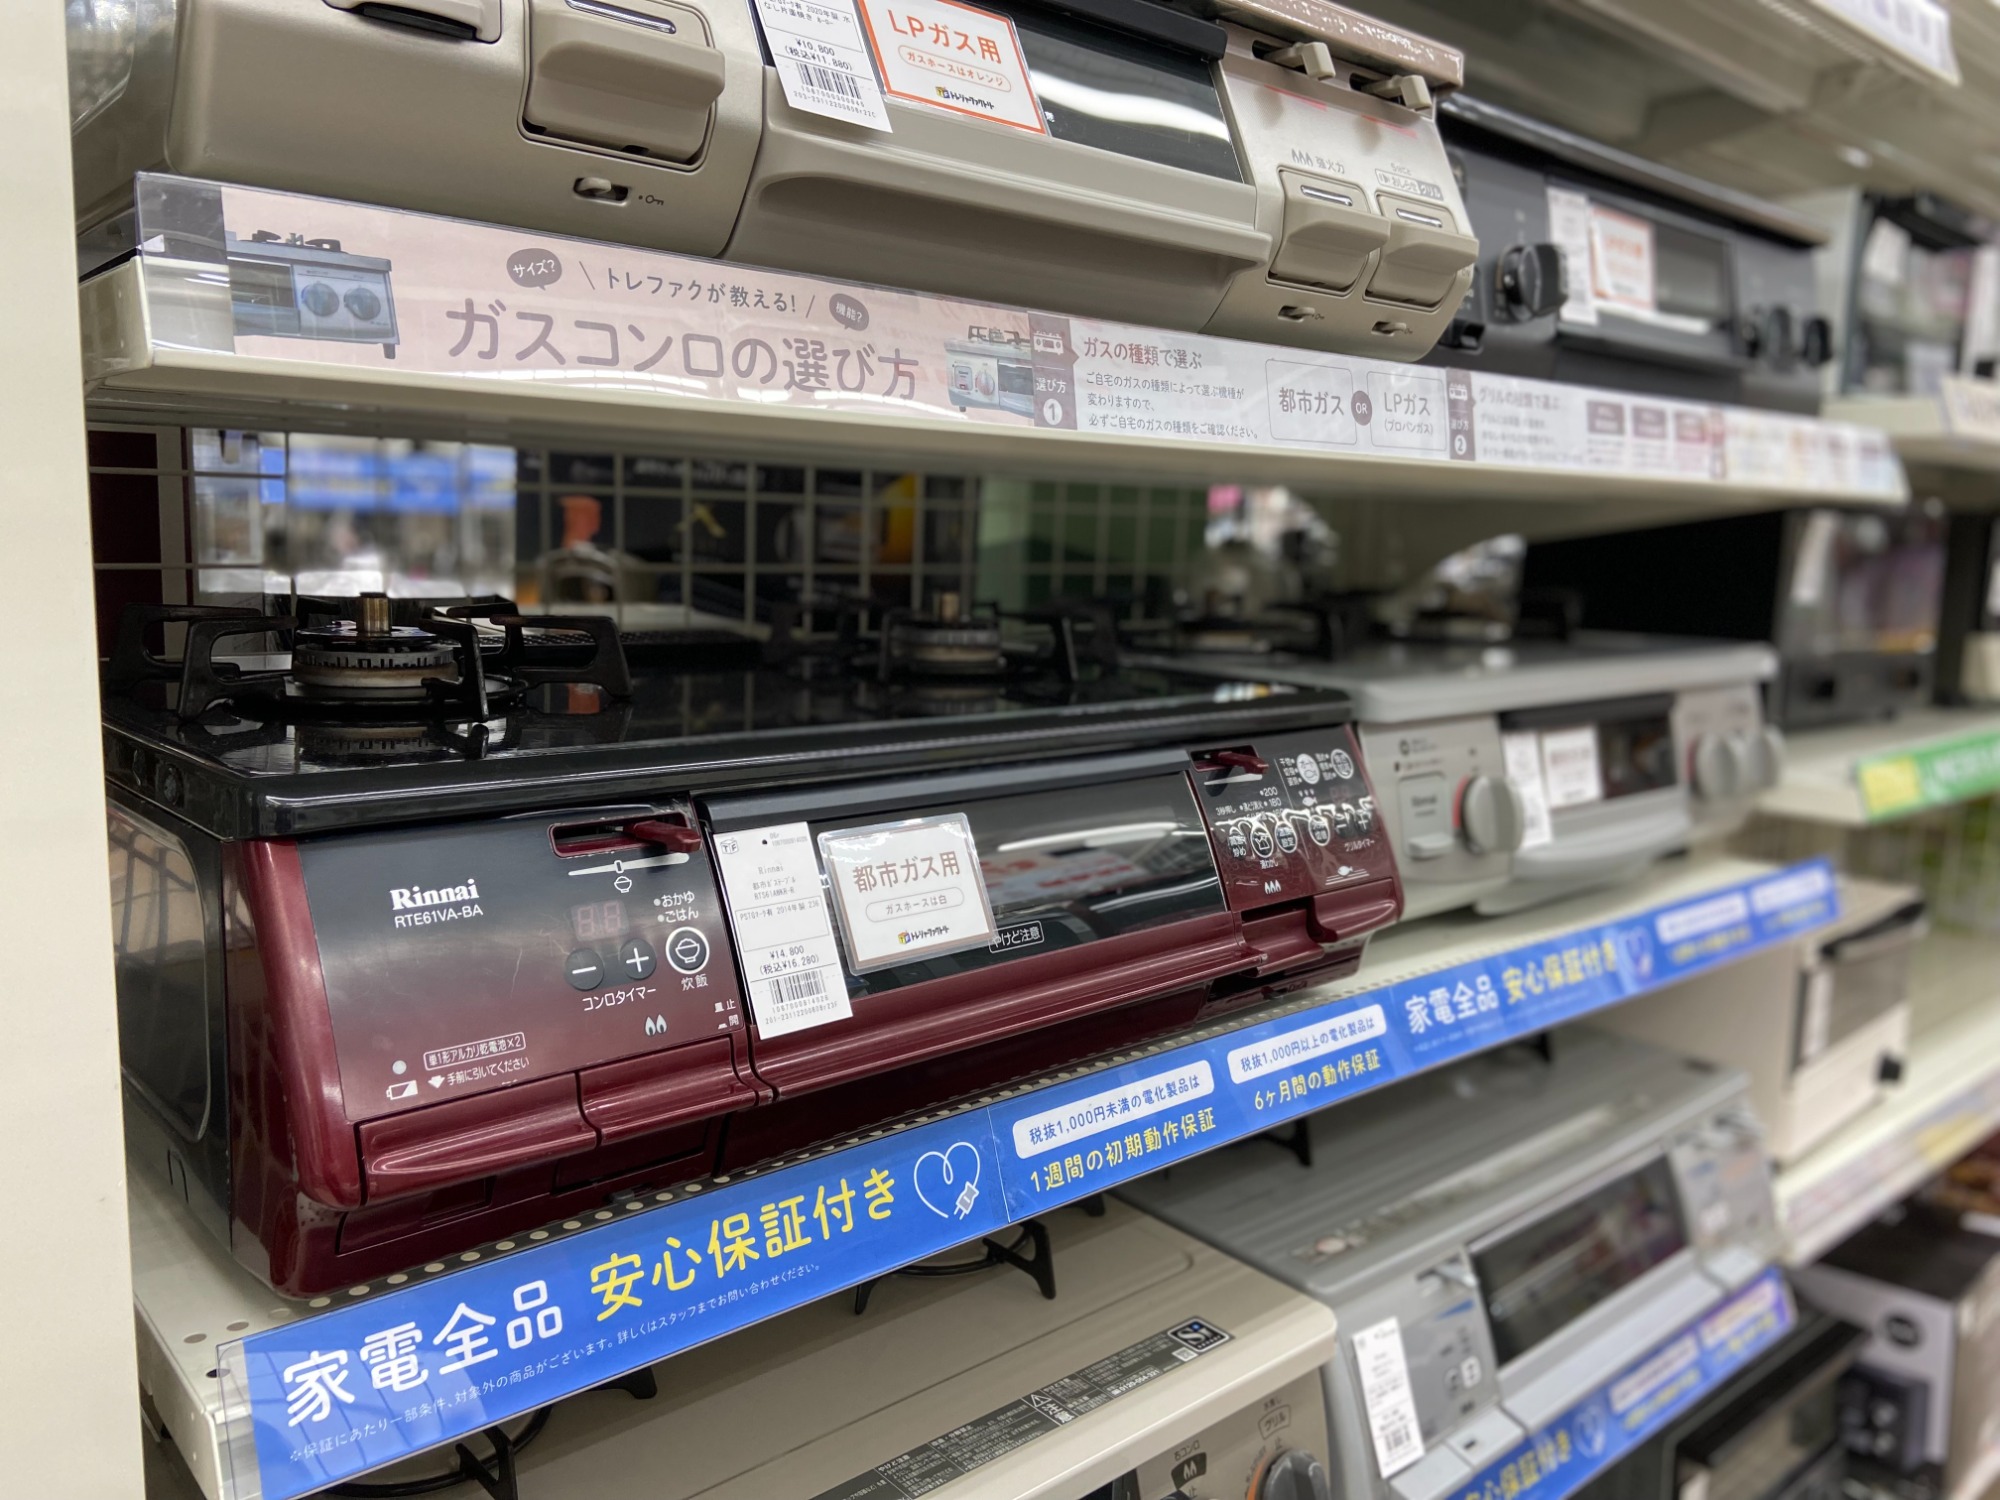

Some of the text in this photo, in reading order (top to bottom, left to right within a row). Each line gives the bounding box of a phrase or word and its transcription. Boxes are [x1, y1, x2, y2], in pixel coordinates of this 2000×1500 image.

[888, 9, 1002, 64] LPガス用
[907, 51, 1004, 86] ガスホースはオレンジ
[512, 258, 557, 279] サイズ?
[606, 266, 797, 313] トレファクが教える!
[835, 300, 864, 324] 機能?
[445, 298, 920, 399] ガスコンロの選び方
[1083, 336, 1203, 369] ガスの種類で選ぶ
[1034, 377, 1068, 394] 選び方
[1086, 372, 1245, 400] ご自宅のガスの種類によって選ぶ機種が
[1087, 393, 1156, 411] 変わりますので、
[1278, 386, 1345, 416] 都市ガス
[1355, 402, 1368, 415] OR
[1383, 391, 1431, 417] LPガス
[1088, 413, 1259, 439] 必ずご自宅のガスの種類をご確認ください。
[1383, 419, 1434, 435] (プロパンガス)
[1263, 786, 1278, 797] 200
[1269, 797, 1282, 807] 180
[758, 865, 784, 875] Rinnai
[852, 850, 961, 894] 都市ガス用
[389, 878, 480, 910] Rinnai
[662, 890, 695, 908] おかゆ
[886, 895, 948, 915] ガスホースは白
[394, 904, 484, 929] RTE61VA-BA
[666, 906, 699, 923] ごはん
[991, 925, 1042, 948] やけど注意
[681, 973, 709, 991] 炊飯
[582, 986, 657, 1011] コンロタイマー
[726, 999, 737, 1010] 止
[1404, 974, 1499, 1036] 家電全品
[1239, 1015, 1375, 1074] 税抜1,000円以上の電化製品は
[446, 1057, 531, 1086] 手前に引いてください
[1254, 1047, 1381, 1111] 6ヶ月間の動作保証
[1028, 1072, 1201, 1146] 税抜1,000円未満の電化製品は
[1030, 1106, 1217, 1194] 1週間の初期動作保証
[281, 1166, 897, 1428] 家電全品 安心保証付き
[1263, 1411, 1286, 1432] グリル
[1174, 1439, 1200, 1462] 右コンロ
